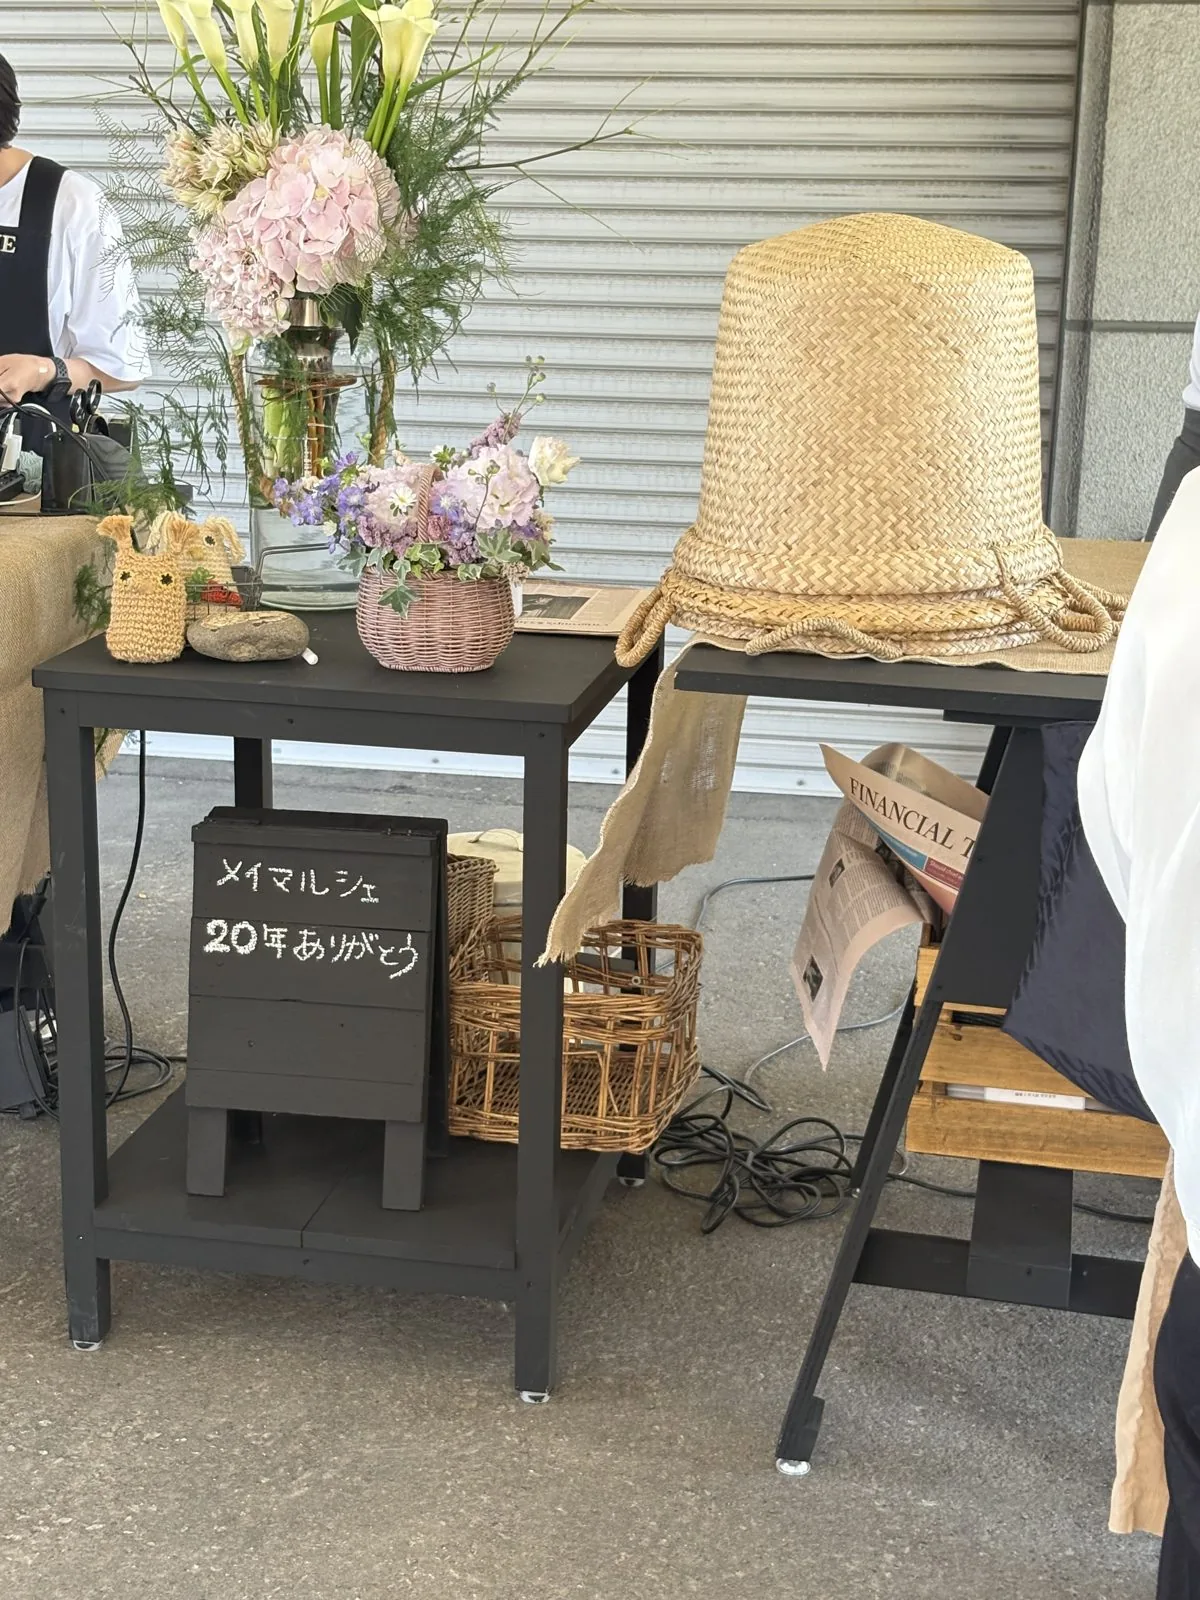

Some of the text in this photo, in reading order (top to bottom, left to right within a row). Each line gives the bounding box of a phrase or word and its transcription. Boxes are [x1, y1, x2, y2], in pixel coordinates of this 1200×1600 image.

[0, 234, 17, 254] E
[849, 776, 955, 850] FINANCIAL
[216, 858, 379, 903] メイマルシェ
[203, 919, 418, 979] 20年ありがとう
